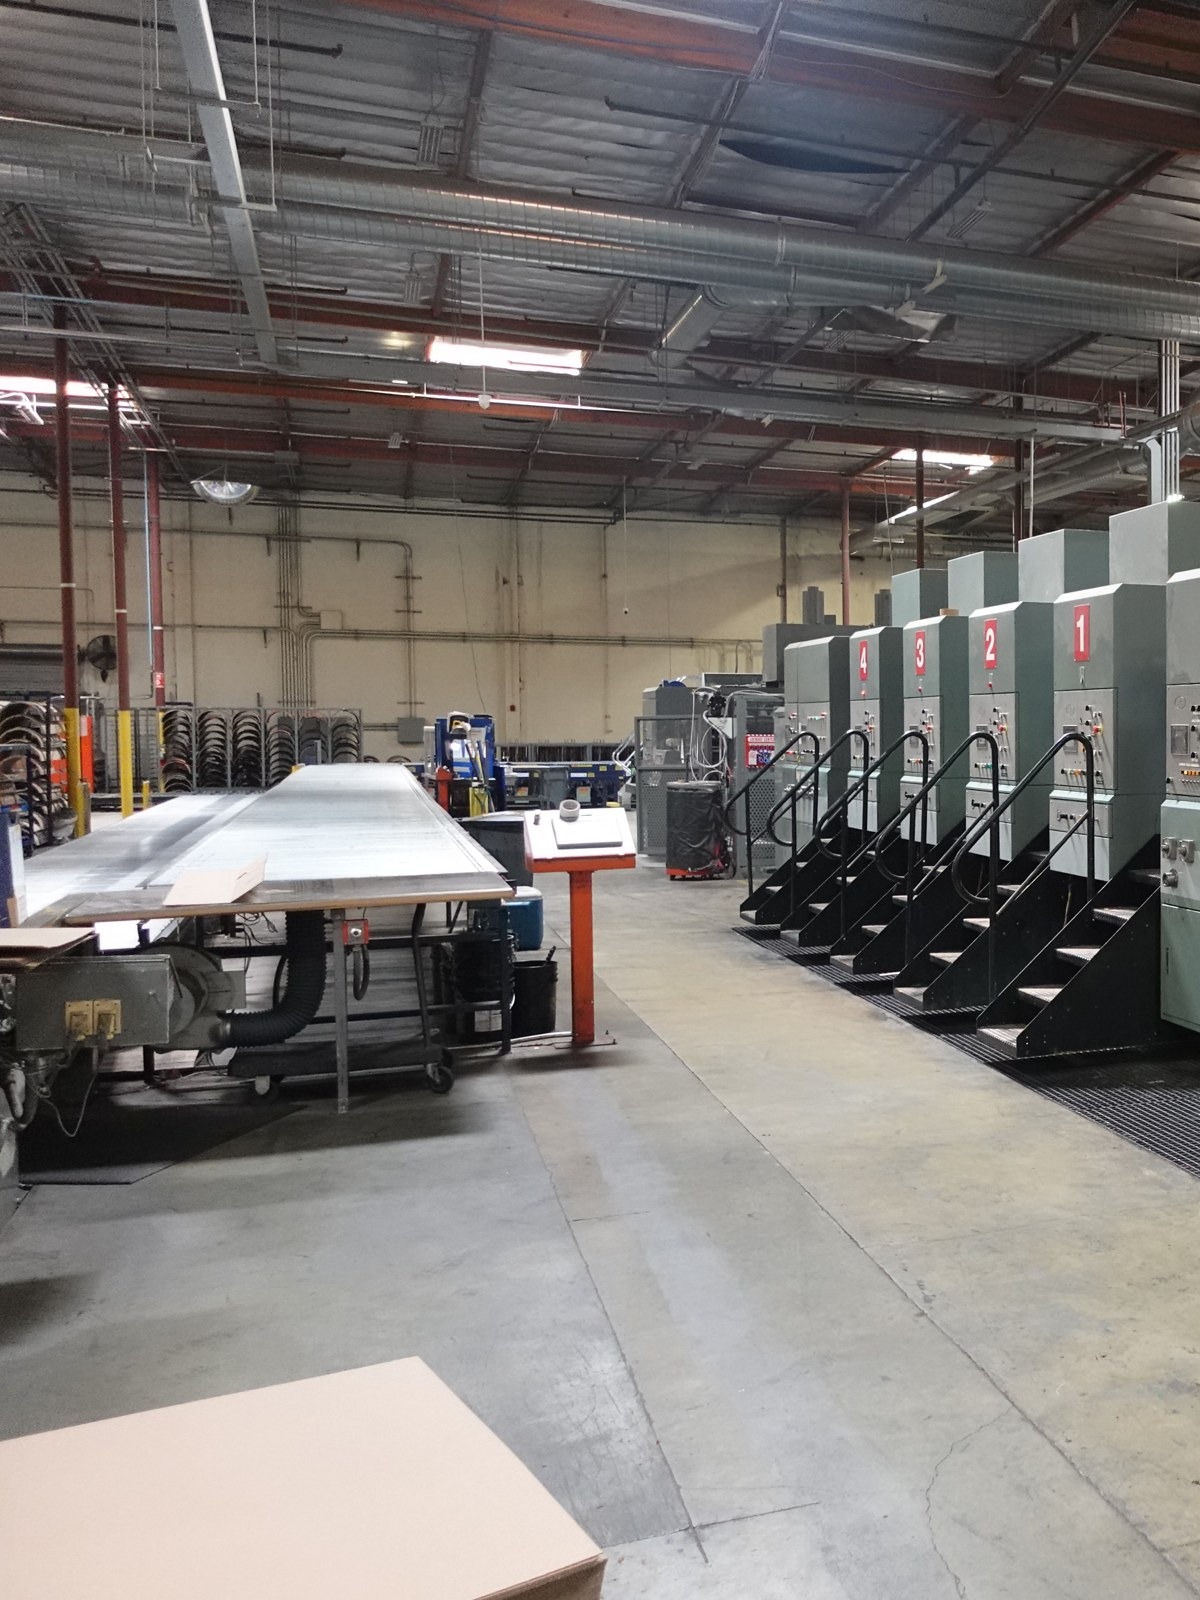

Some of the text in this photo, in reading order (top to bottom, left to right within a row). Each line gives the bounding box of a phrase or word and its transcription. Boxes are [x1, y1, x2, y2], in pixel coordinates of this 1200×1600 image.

[985, 628, 995, 661] 2
[1076, 614, 1085, 652] 1
[860, 647, 867, 674] 4
[916, 638, 924, 668] 3
